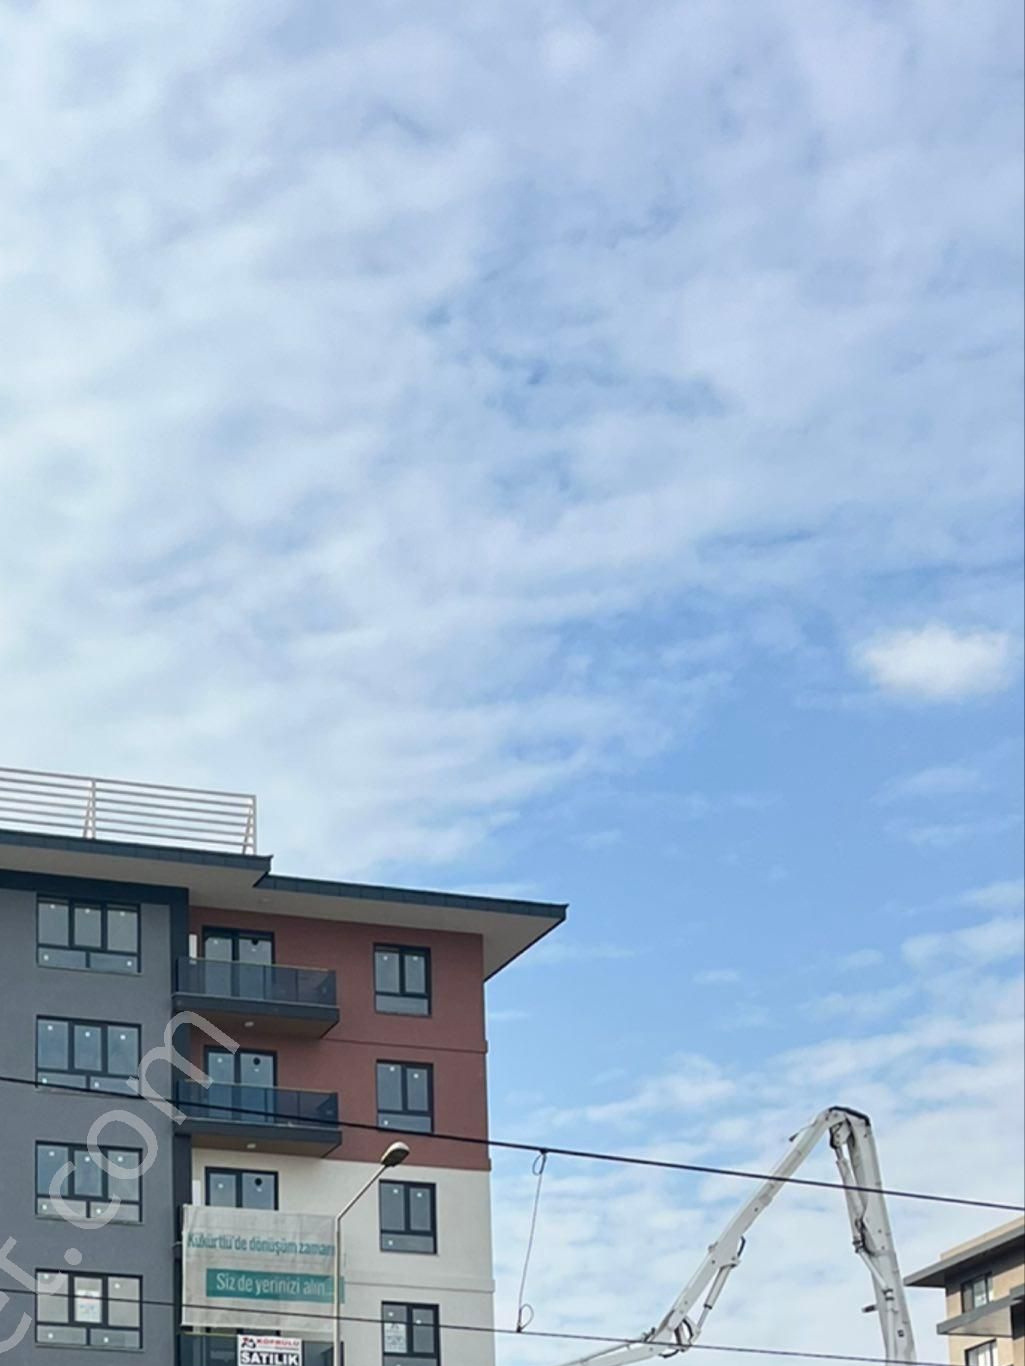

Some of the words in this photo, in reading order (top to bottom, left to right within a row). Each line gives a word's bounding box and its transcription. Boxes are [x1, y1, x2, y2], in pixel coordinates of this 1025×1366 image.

[216, 1272, 236, 1291] Siz
[238, 1274, 252, 1291] de
[254, 1275, 301, 1296] yerinizi
[241, 1351, 298, 1366] SATILIK
